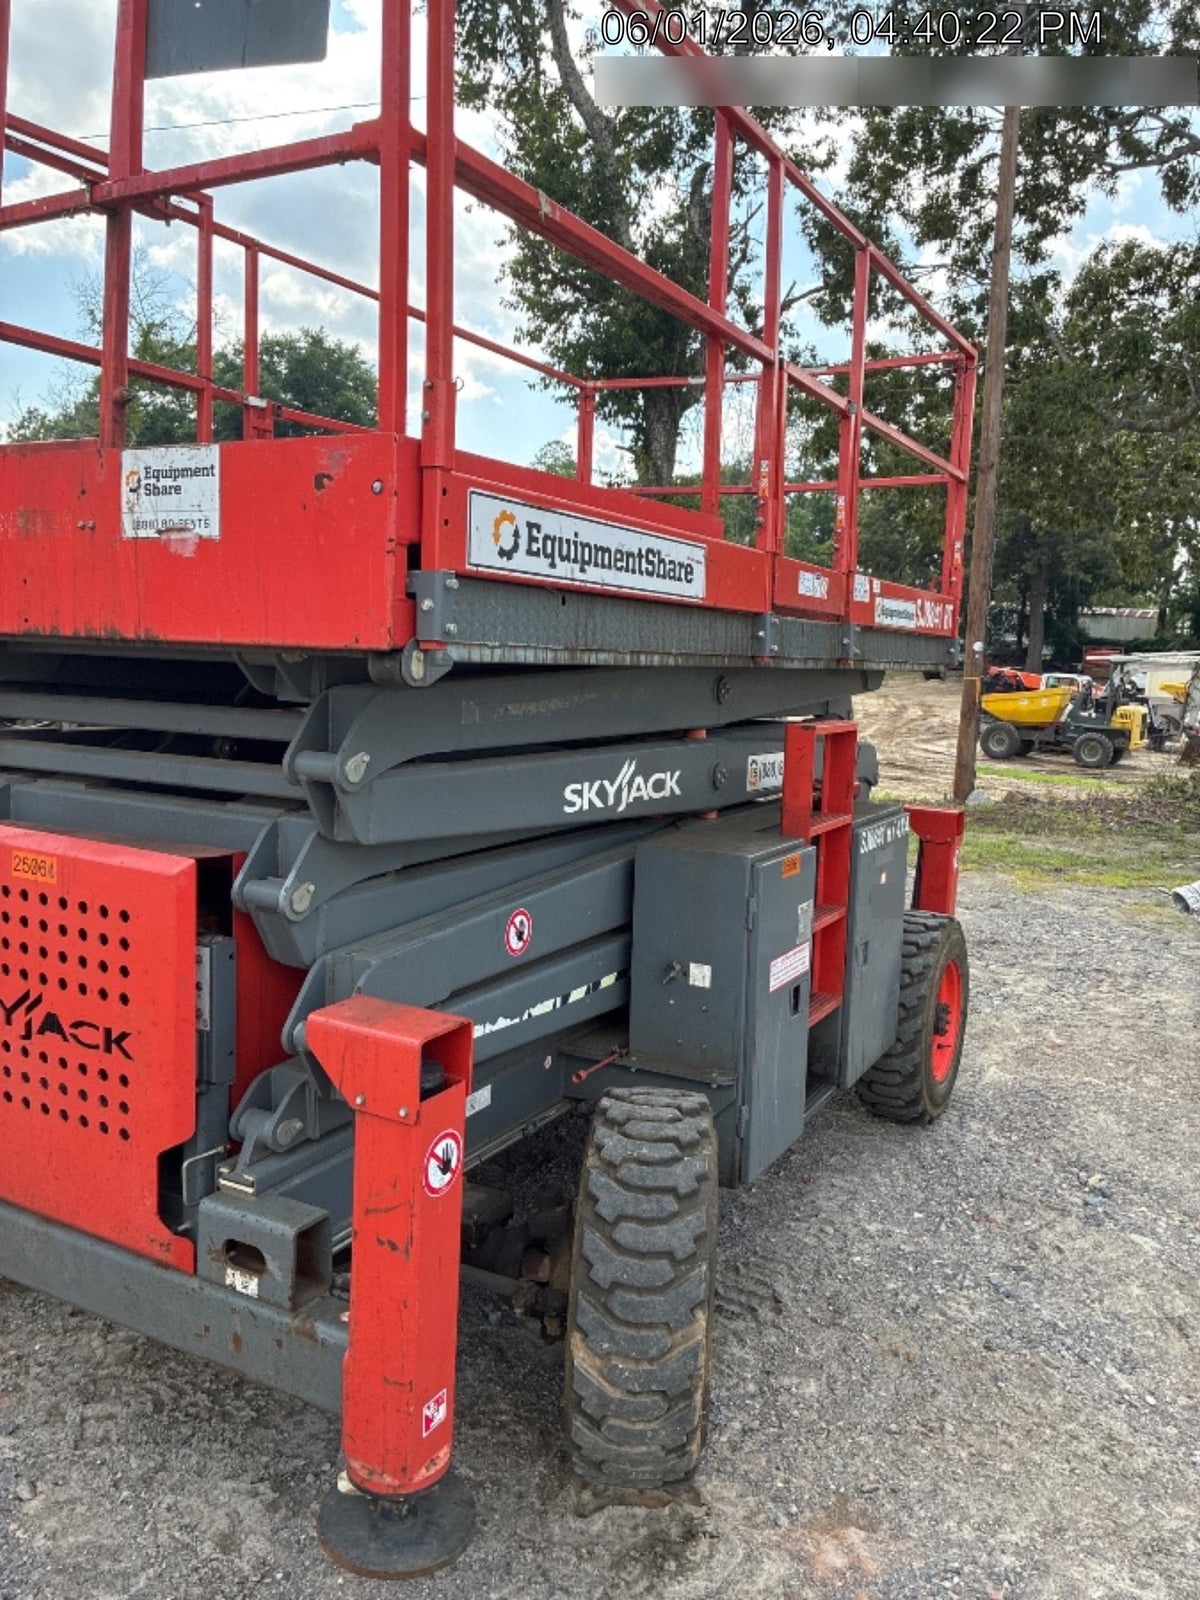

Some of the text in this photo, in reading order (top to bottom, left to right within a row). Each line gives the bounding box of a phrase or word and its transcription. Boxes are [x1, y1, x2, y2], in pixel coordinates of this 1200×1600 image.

[143, 464, 216, 483] Equipment
[143, 483, 182, 497] Share
[524, 520, 695, 585] EquipmentShare
[562, 758, 682, 814] SKYJACK
